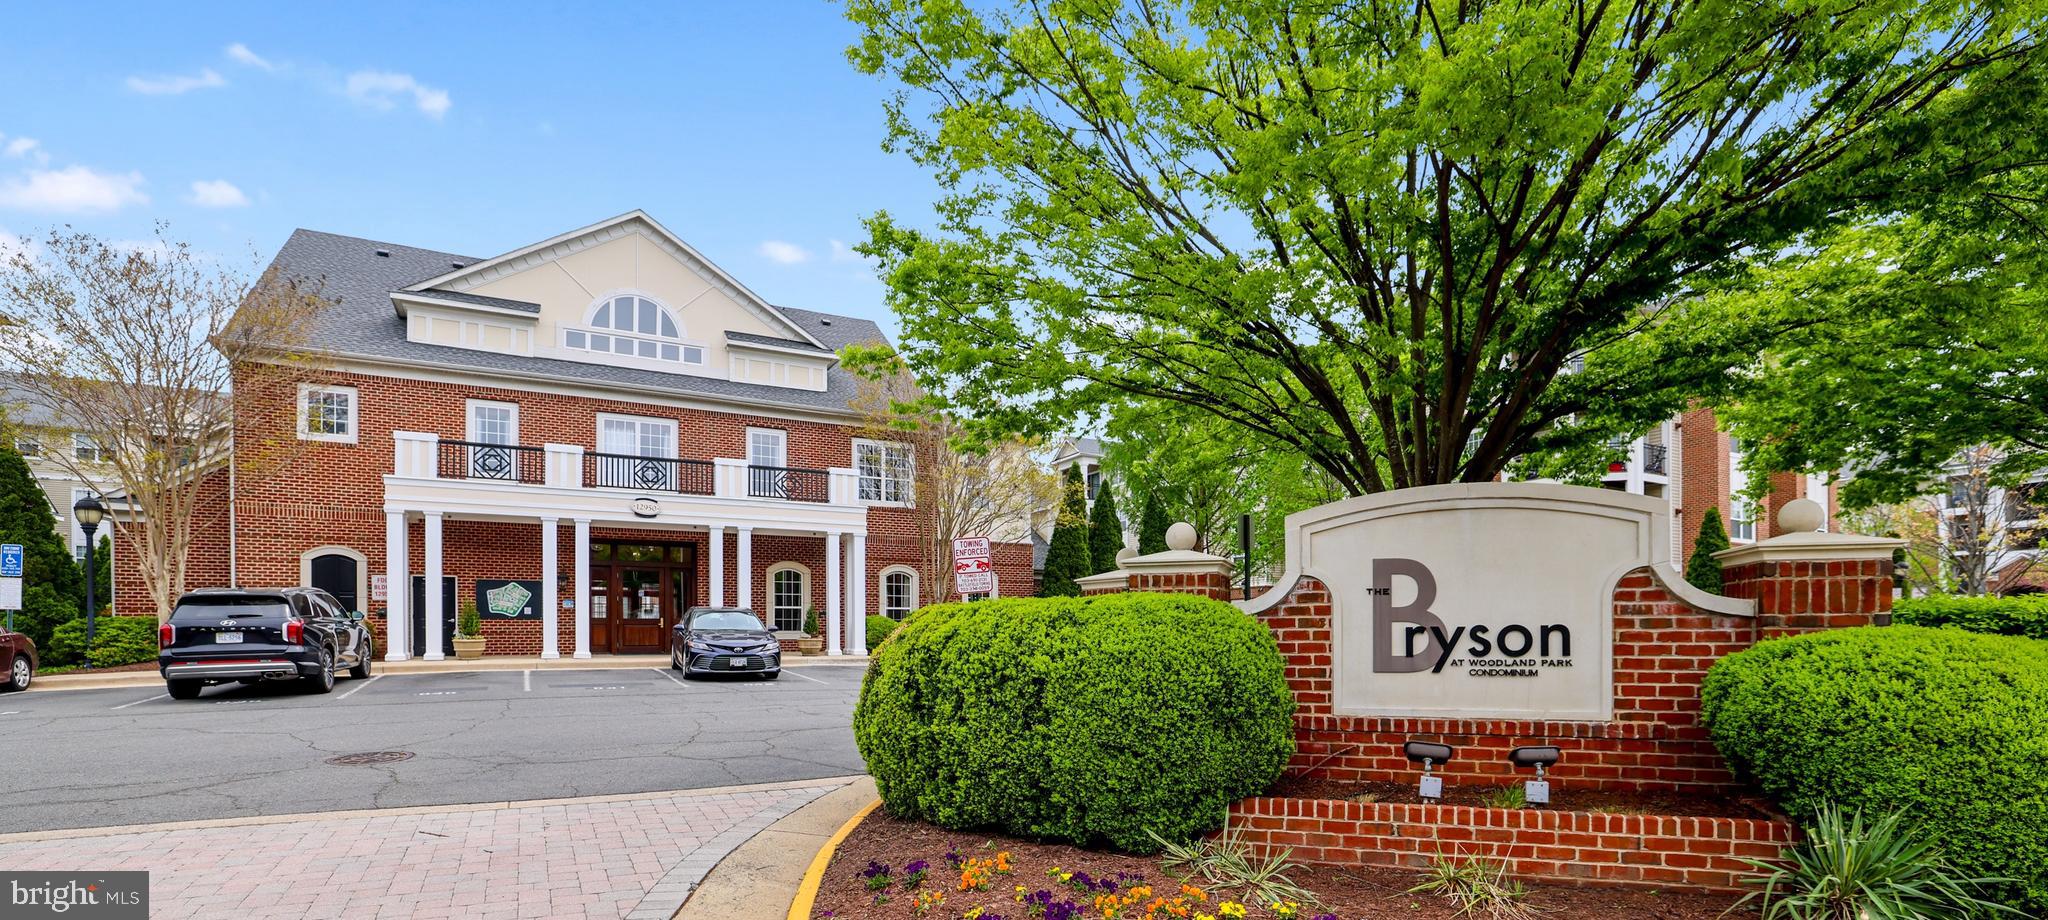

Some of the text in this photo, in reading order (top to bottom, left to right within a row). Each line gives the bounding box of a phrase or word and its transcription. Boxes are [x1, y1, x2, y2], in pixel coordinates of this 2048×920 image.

[960, 540, 983, 548] TOWING
[956, 548, 988, 557] ENFORCED
[1373, 558, 1571, 674] Bryson
[1450, 659, 1573, 667] AT WOODLAND PARK
[1469, 668, 1539, 677] CONDOMINIUM
